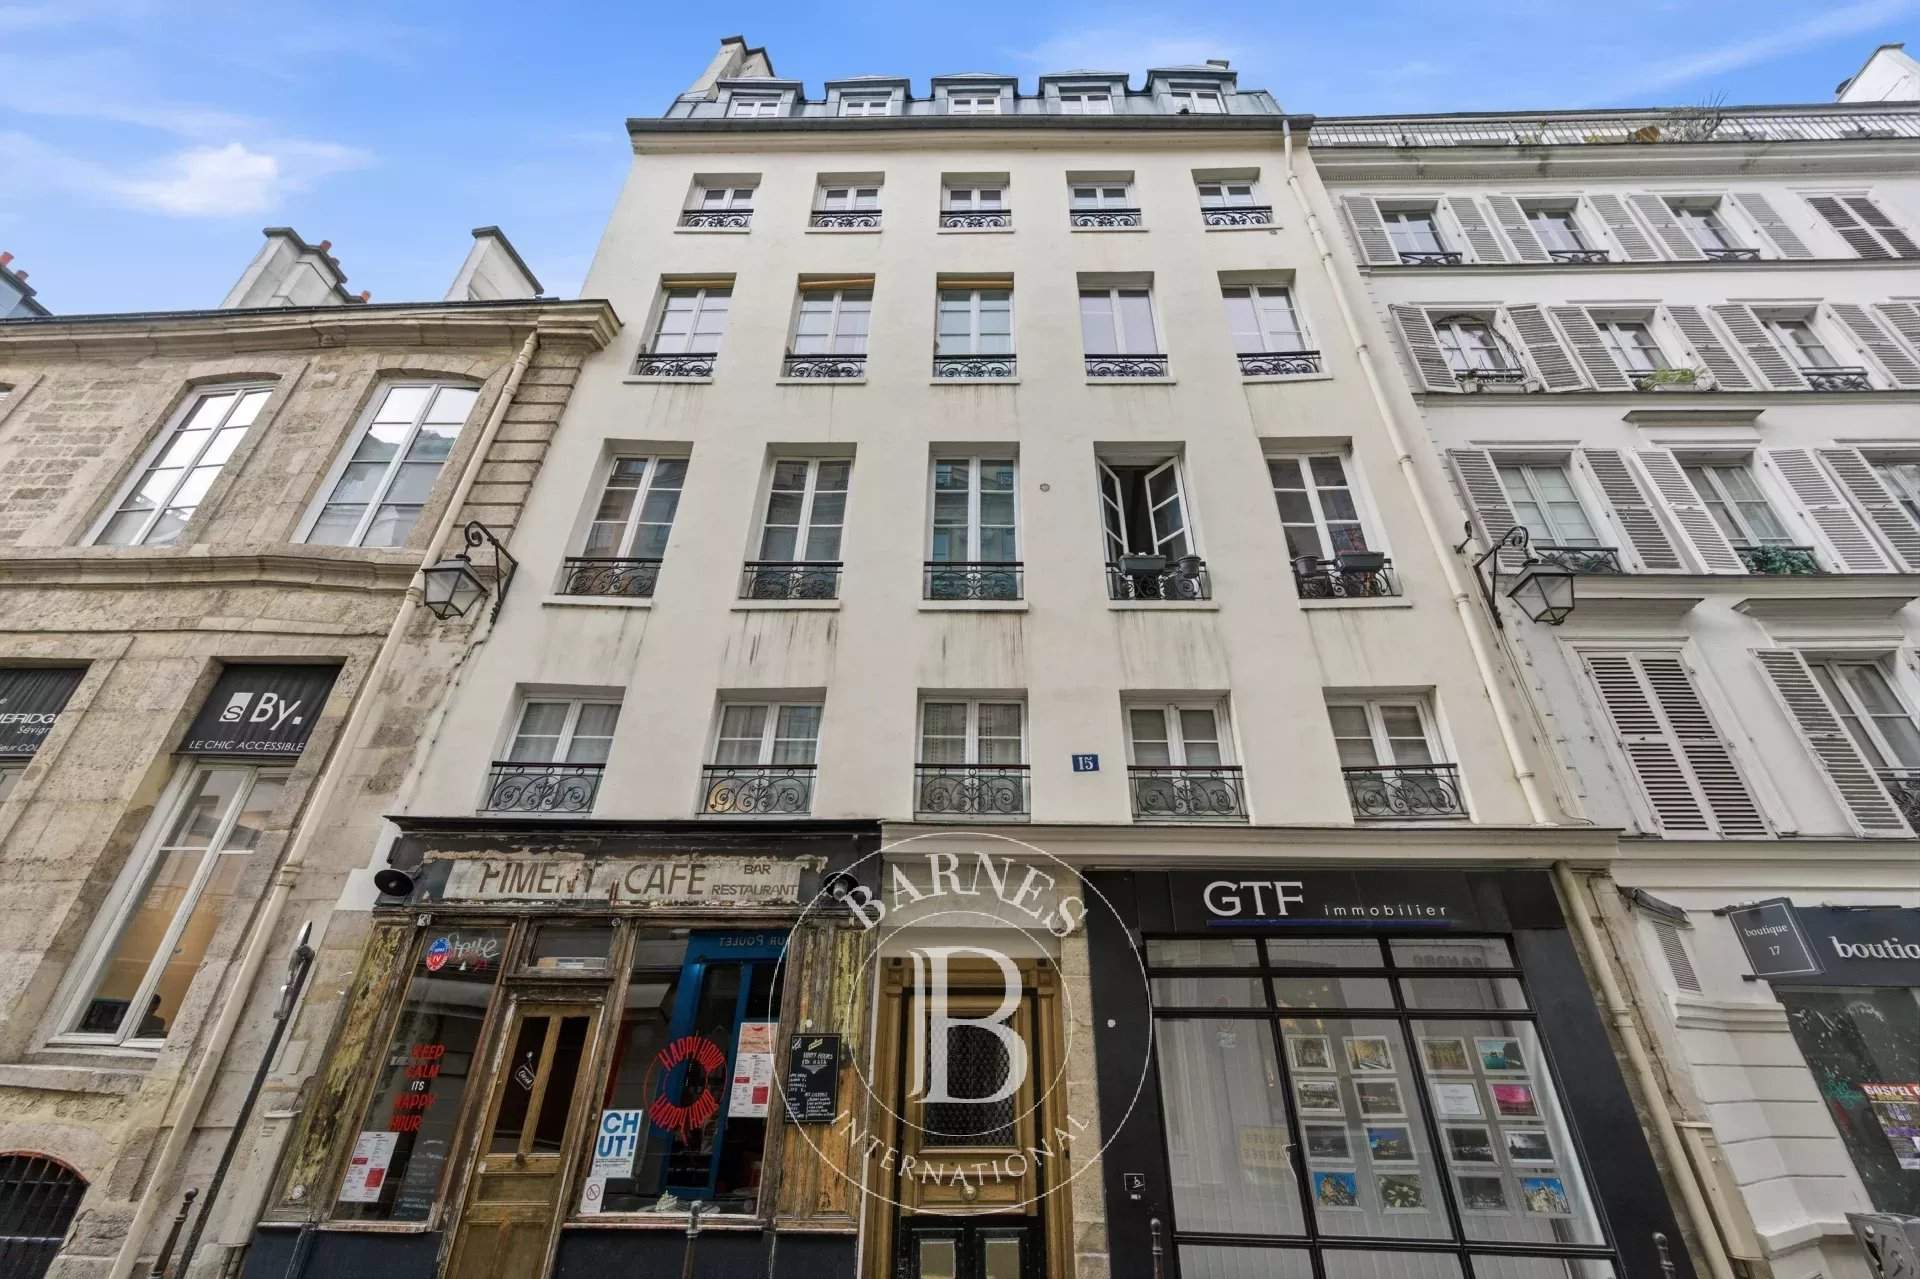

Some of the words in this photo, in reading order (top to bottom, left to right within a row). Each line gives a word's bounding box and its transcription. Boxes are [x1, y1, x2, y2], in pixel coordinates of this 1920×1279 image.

[249, 692, 303, 731] By.
[189, 740, 203, 750] LE
[204, 740, 235, 750] CHIC
[236, 740, 305, 752] ACCESSIBLE
[1079, 756, 1094, 770] 15
[743, 864, 771, 875] BAR
[711, 884, 799, 896] RESTAURANT
[1203, 881, 1304, 917] GTF
[1325, 904, 1447, 917] immobilier
[1744, 923, 1788, 938] boutique
[1768, 945, 1781, 957] 17
[411, 1081, 425, 1091] ITS
[1863, 1085, 1914, 1097] GOSPEL
